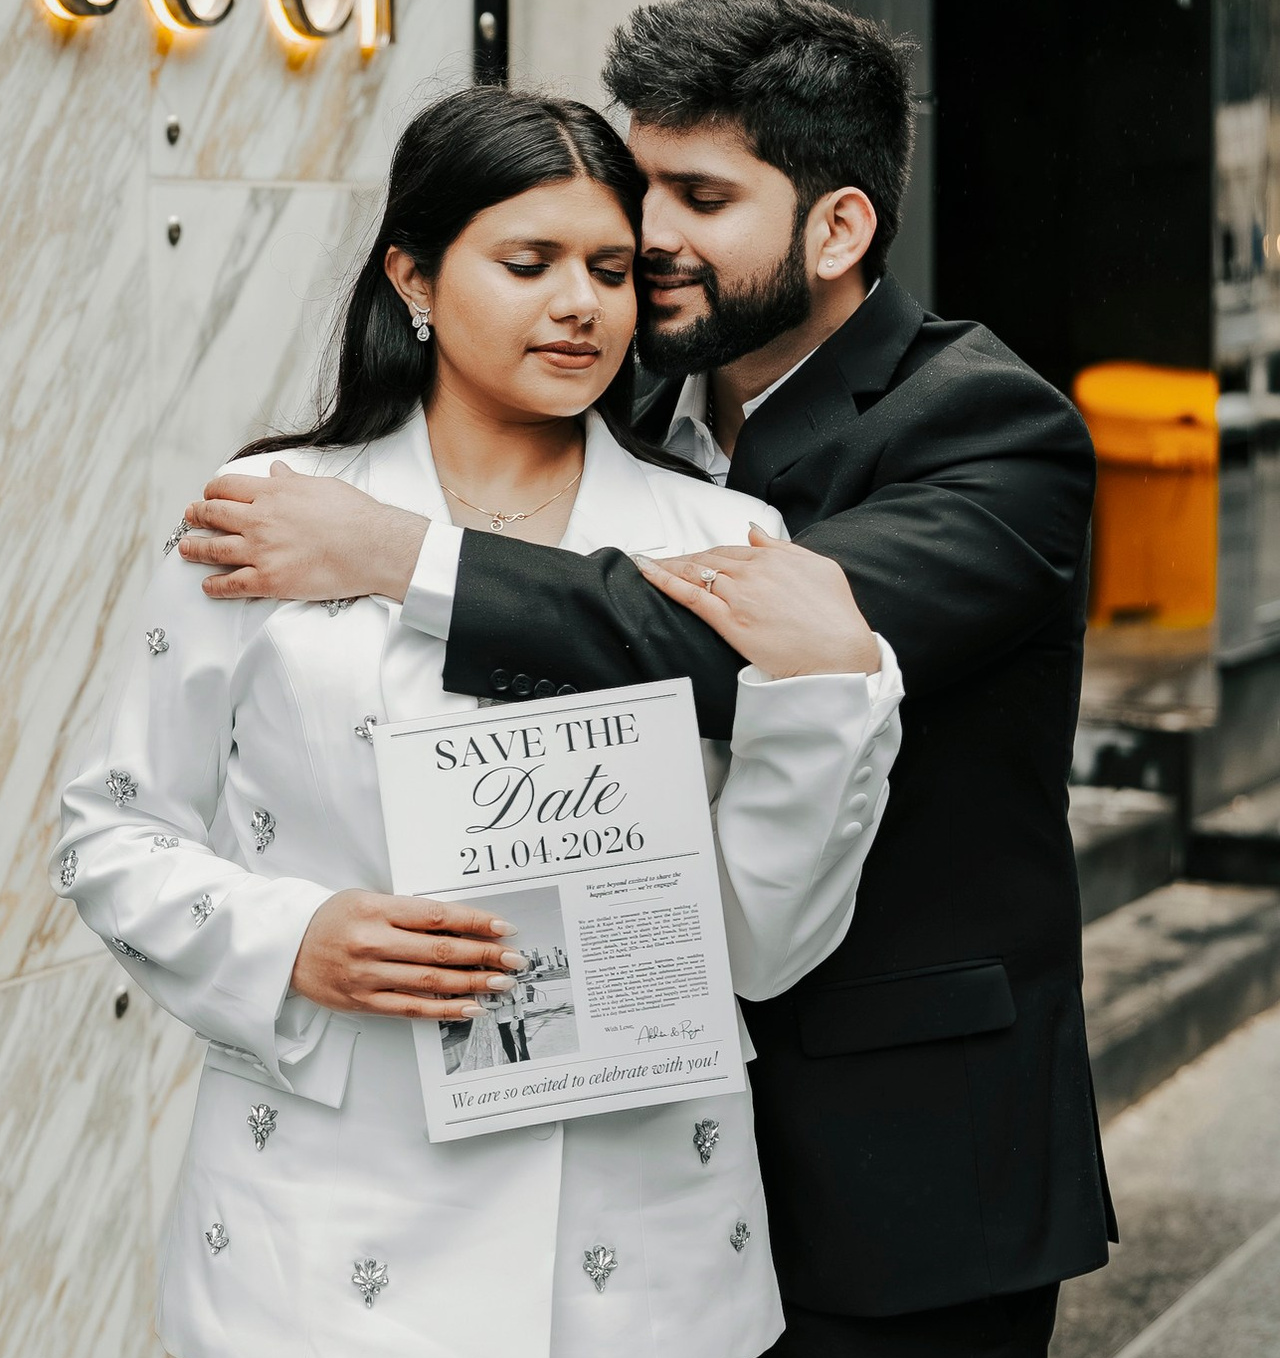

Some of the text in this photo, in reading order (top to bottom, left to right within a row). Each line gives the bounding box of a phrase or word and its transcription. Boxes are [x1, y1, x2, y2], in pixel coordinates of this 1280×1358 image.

[434, 713, 640, 771] SAVE THE
[465, 763, 628, 834] Date
[460, 822, 645, 875] 21.04.2026
[451, 1050, 720, 1109] We are so excited to celebrate with you!
